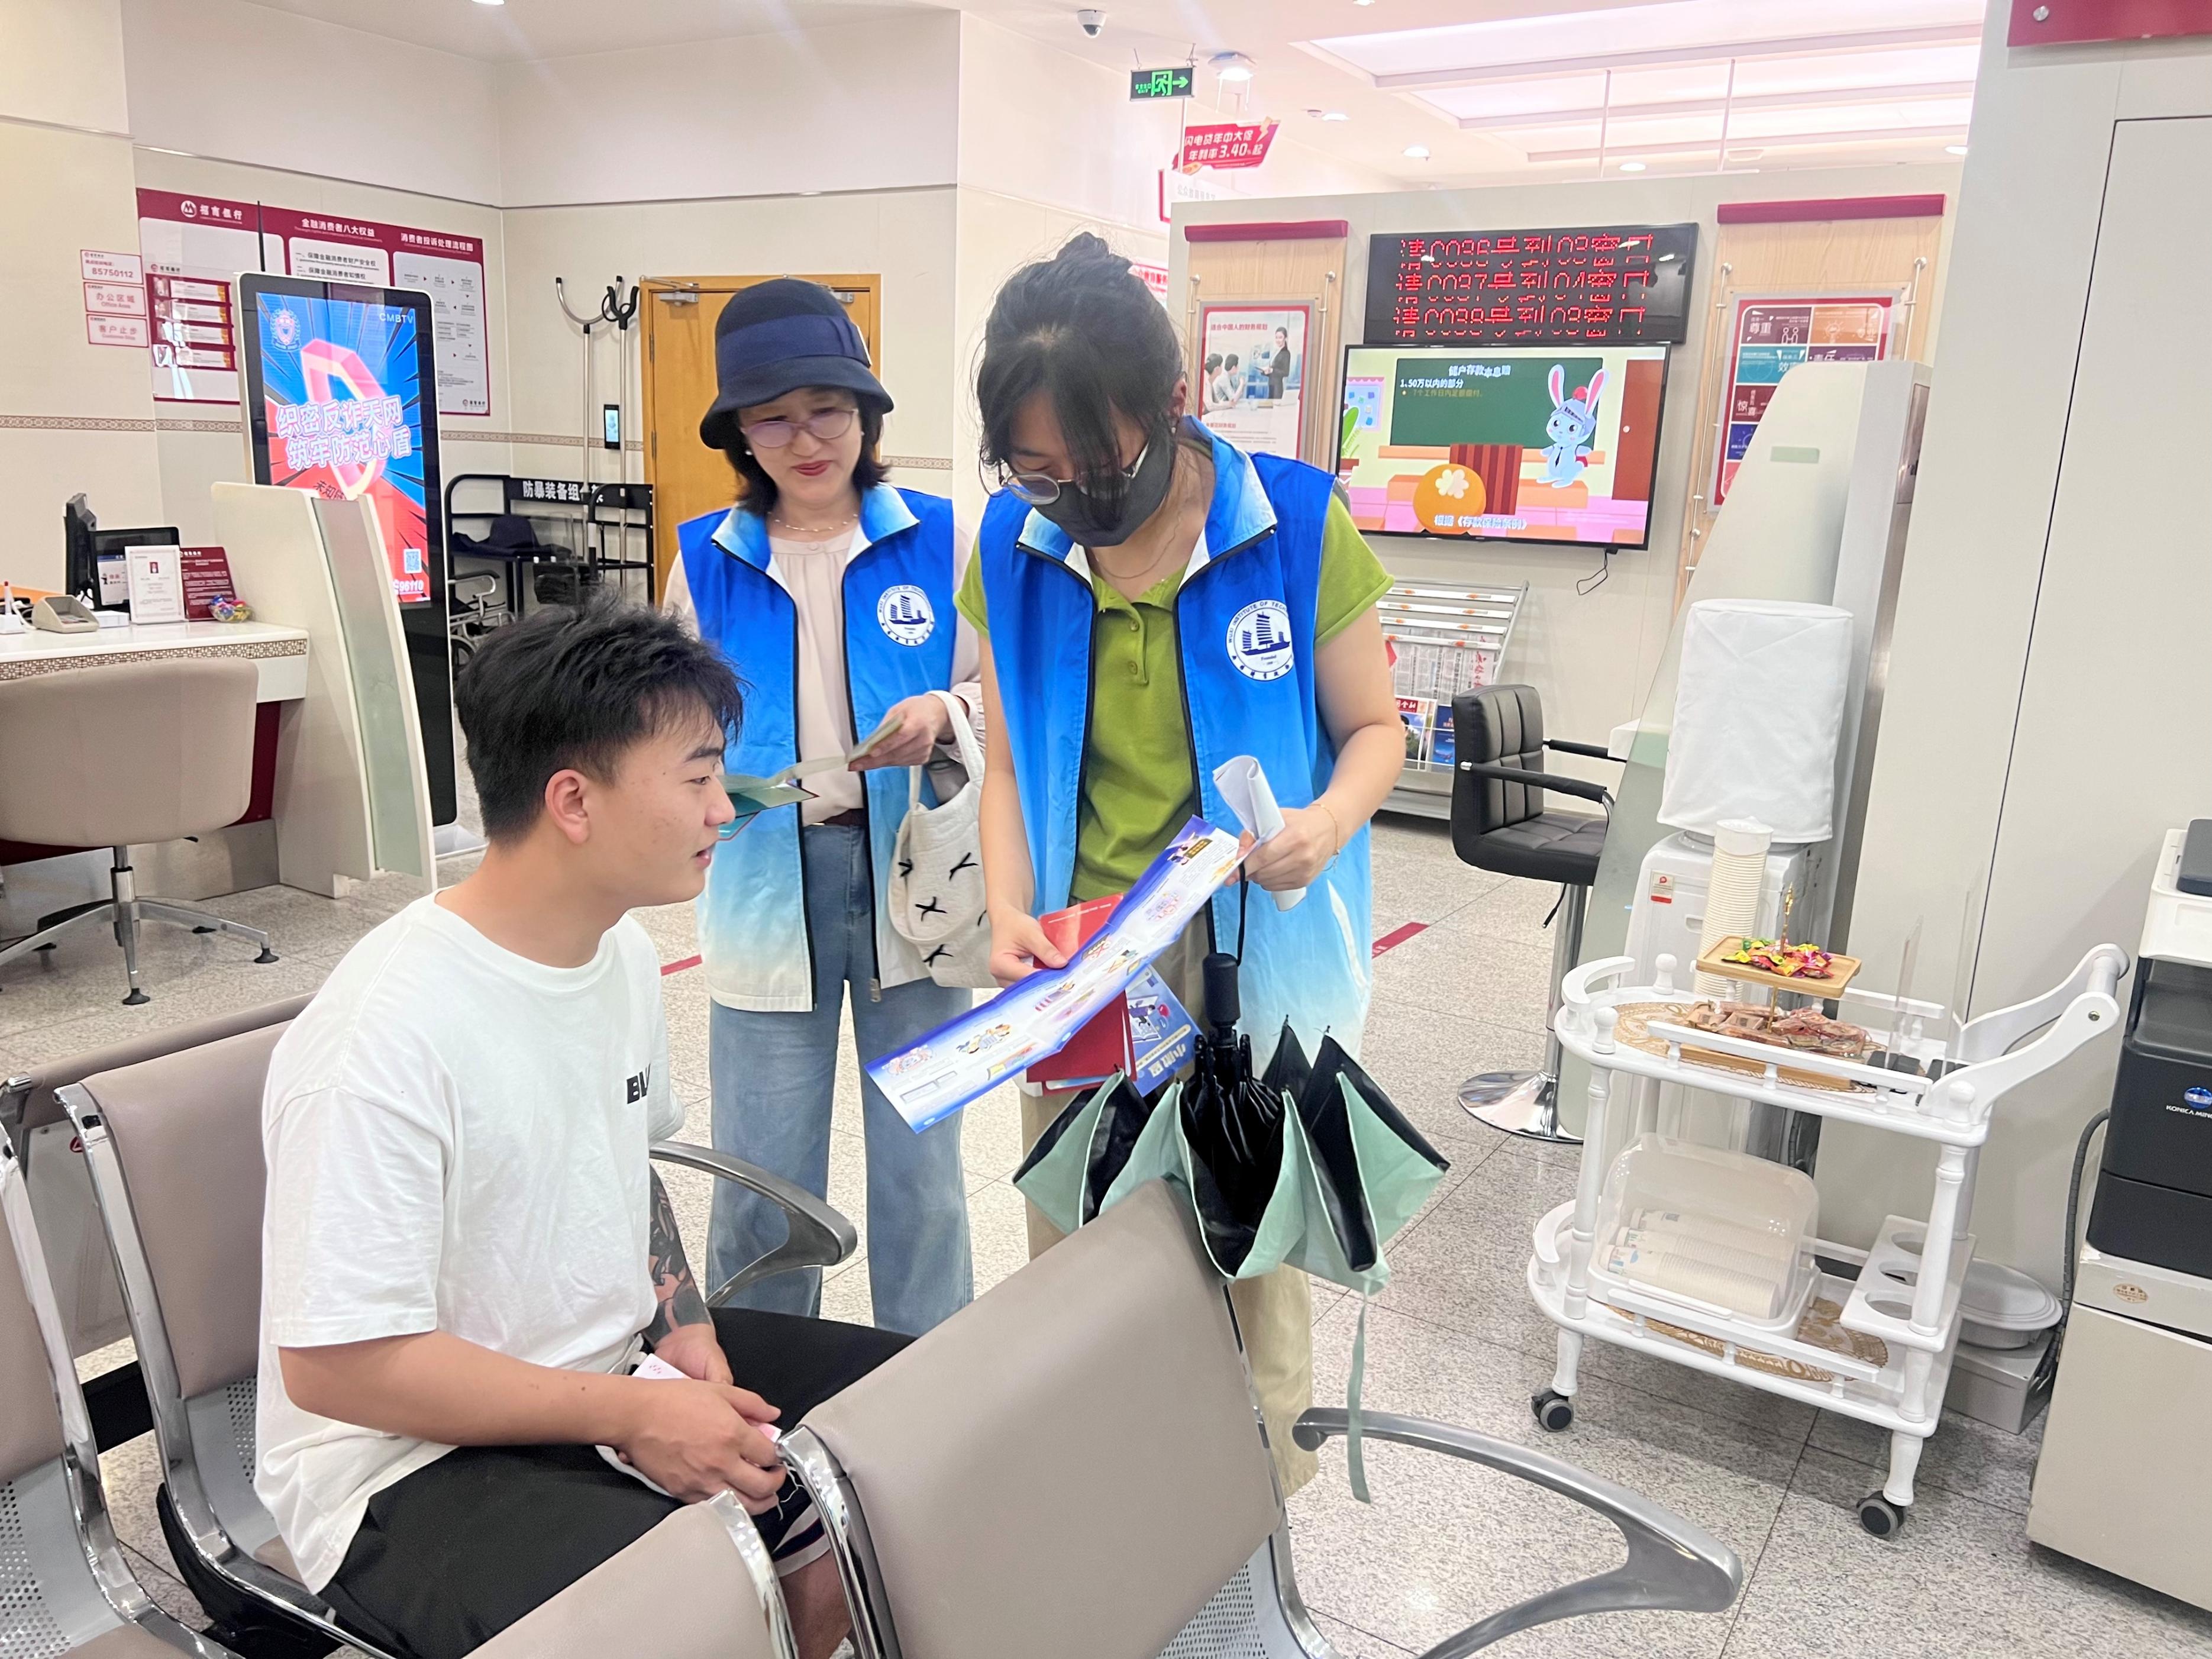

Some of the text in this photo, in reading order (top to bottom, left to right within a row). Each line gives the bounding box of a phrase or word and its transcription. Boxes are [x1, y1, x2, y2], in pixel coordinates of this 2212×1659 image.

[302, 218, 375, 237] 金融消费者八大权益
[92, 267, 133, 278] 85750112
[96, 293, 135, 304] 办公区域
[379, 312, 414, 324] CMBTV
[276, 395, 403, 438] 织密反诈天网
[286, 427, 412, 471] 筑牢防范心盾
[1233, 604, 1257, 626] INSTITUTE
[2166, 1105, 2194, 1115] KONICA
